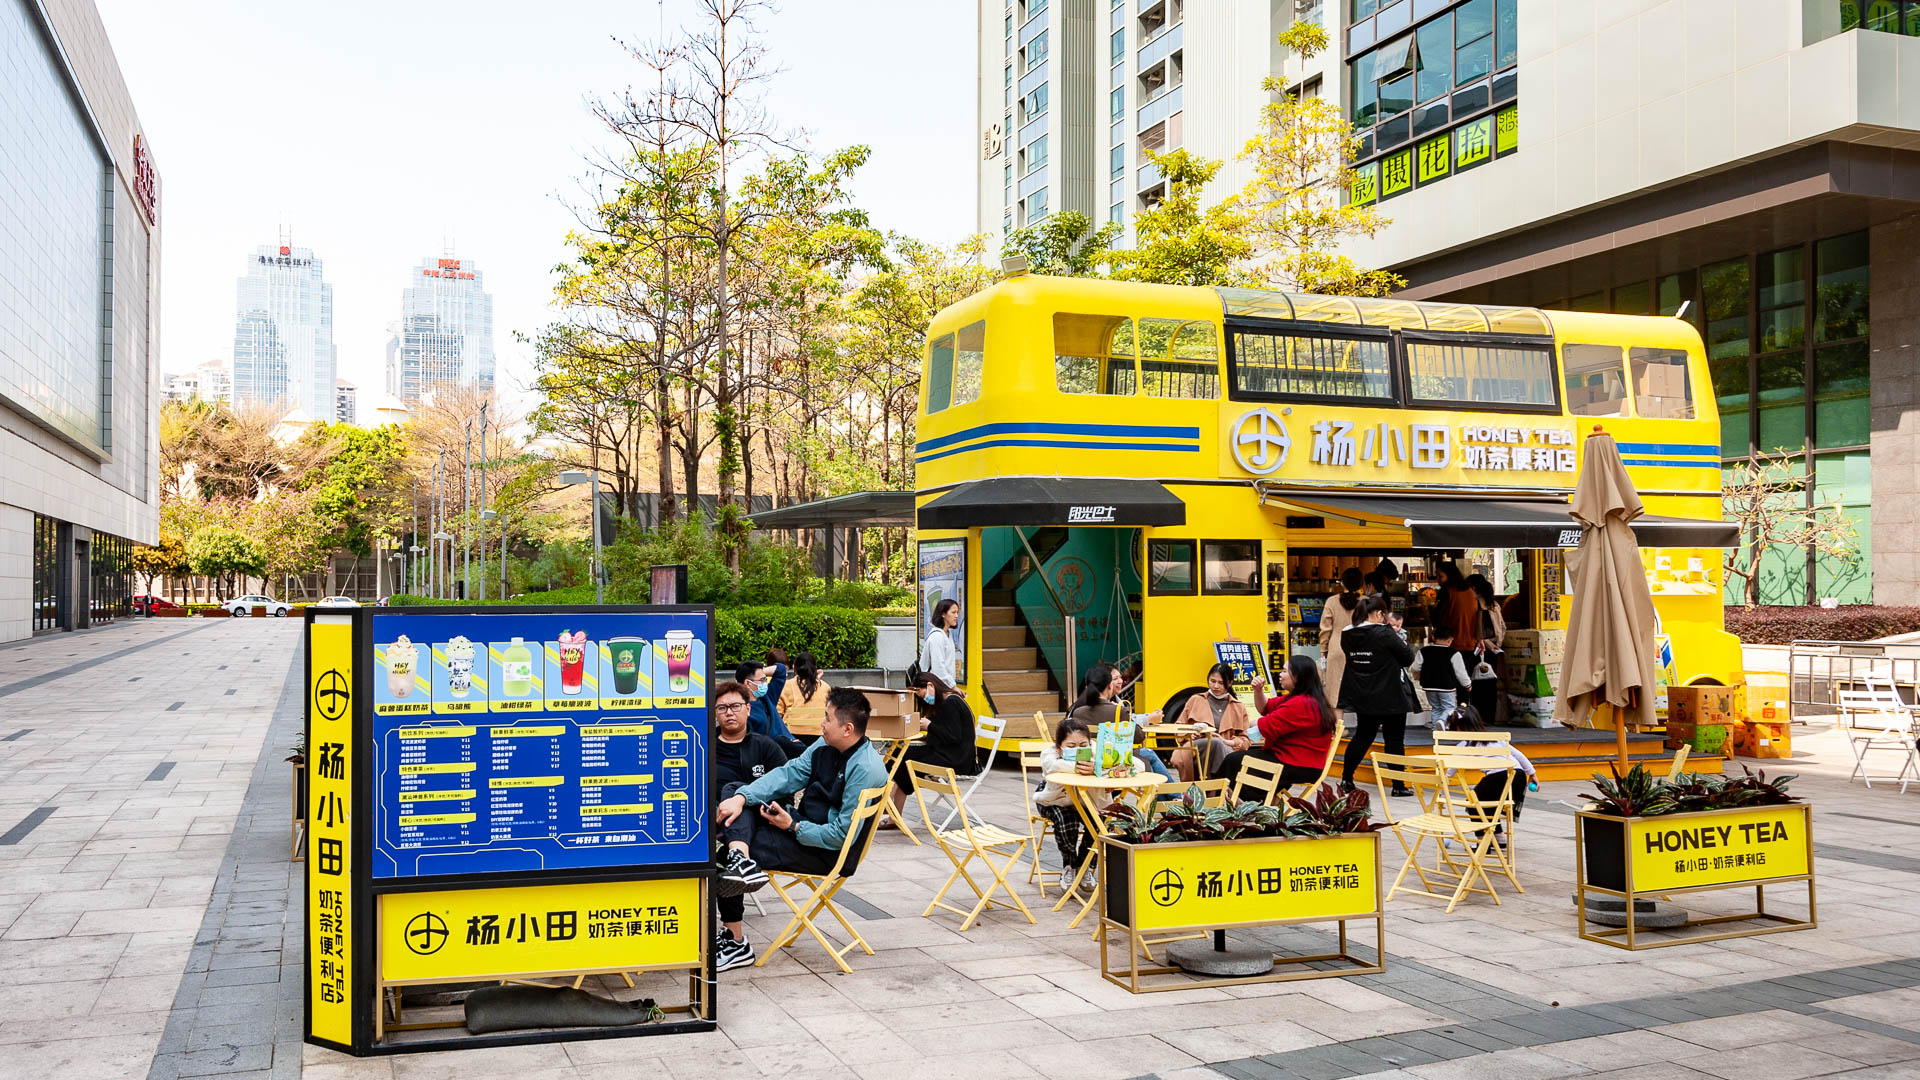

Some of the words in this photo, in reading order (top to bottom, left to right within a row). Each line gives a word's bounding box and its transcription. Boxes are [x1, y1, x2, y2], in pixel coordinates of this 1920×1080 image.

[438, 258, 461, 269] PICC
[1310, 420, 1451, 469] 杨小田
[1462, 425, 1531, 443] HONEY
[1535, 428, 1574, 445] TEA
[1463, 444, 1577, 472] 奶茶便利店
[1068, 505, 1117, 521] 阳光巴士
[317, 742, 345, 876] 杨小田
[567, 835, 601, 845] 一杯好茶
[1645, 825, 1732, 854] HONEY
[1738, 820, 1789, 845] TEA
[1196, 867, 1282, 898] 杨小田
[1289, 865, 1332, 876] HONEY
[1333, 863, 1359, 874] TEA
[1290, 875, 1360, 893] 奶茶便利店
[334, 890, 343, 963] HONEY
[588, 907, 643, 920] HONEY
[646, 905, 679, 917] TEA
[465, 910, 578, 946] 杨小田
[588, 919, 679, 939] 奶茶便利店
[319, 889, 335, 1004] 奶茶便利店
[336, 964, 345, 1004] TEA
